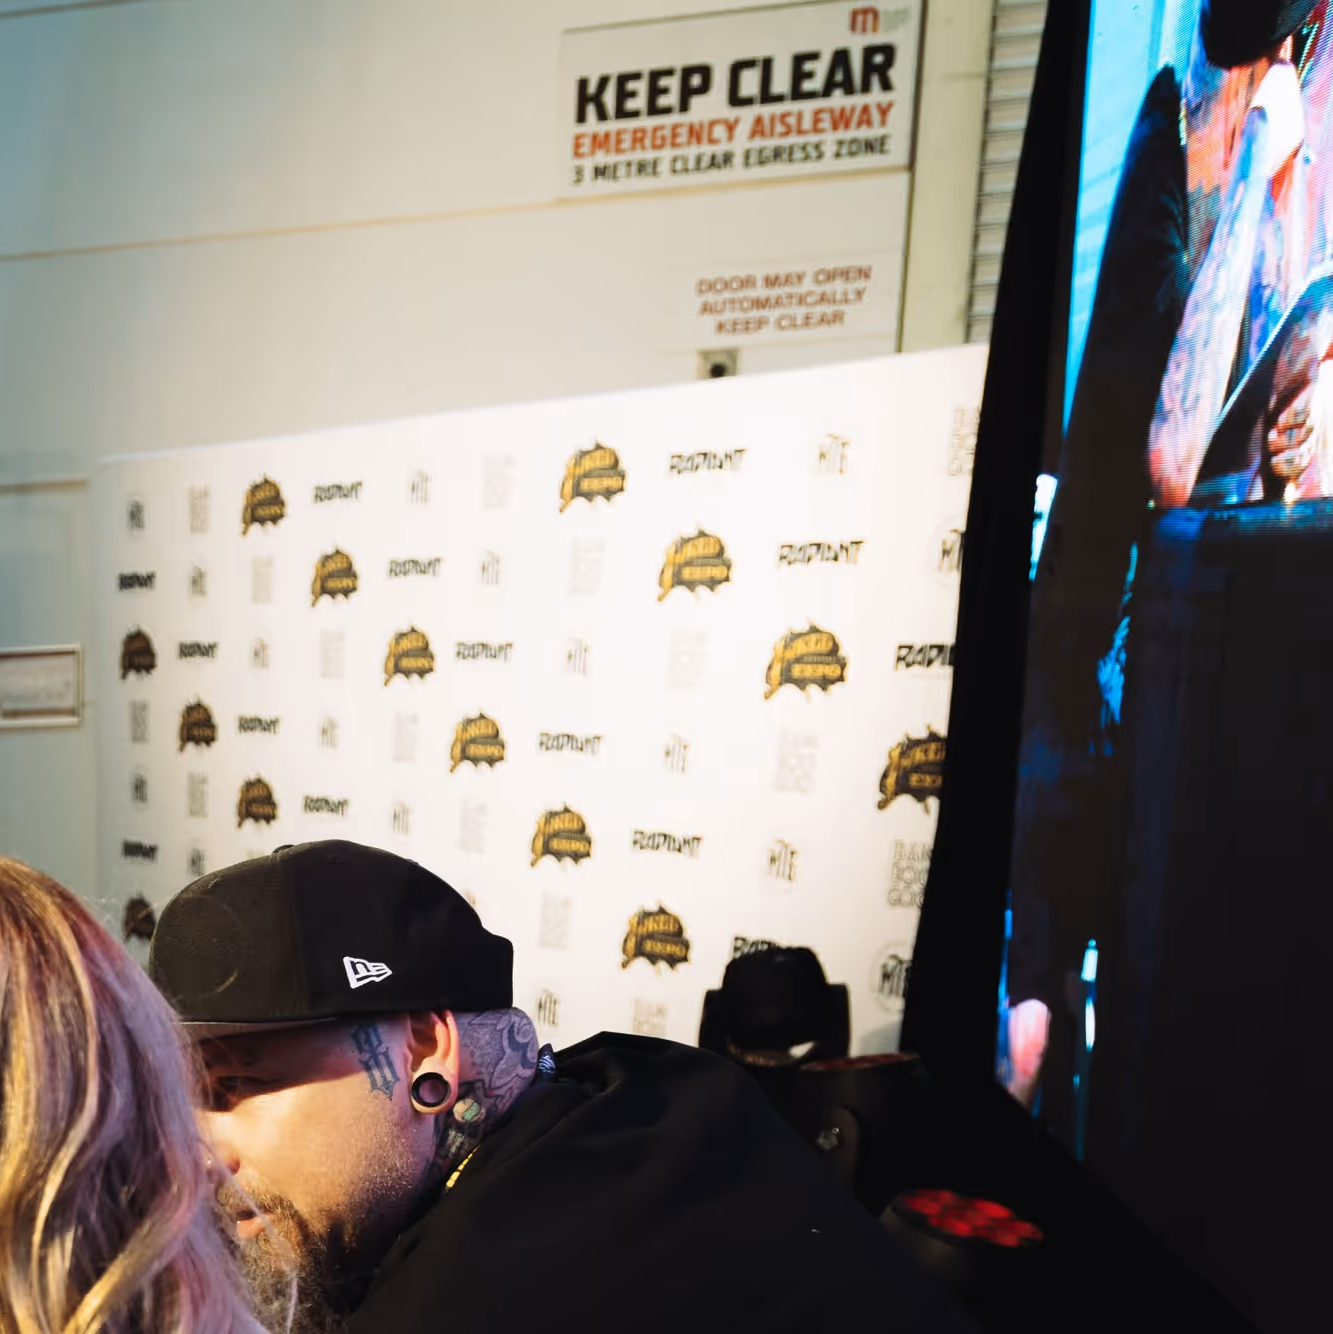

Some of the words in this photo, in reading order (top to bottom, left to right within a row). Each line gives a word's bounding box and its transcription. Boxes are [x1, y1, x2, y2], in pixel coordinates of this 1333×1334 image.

[575, 63, 713, 124] KEEP
[726, 42, 897, 108] CLEAR
[572, 116, 740, 159] EMERGENCY
[748, 100, 896, 140] AISLEWAY
[573, 164, 584, 185] 3
[592, 156, 662, 182] METRE
[670, 150, 734, 176] CLEAR
[743, 141, 825, 169] EGRESS
[833, 134, 892, 160] ZONE
[695, 273, 757, 295] DOOR
[763, 271, 807, 290] MAY
[812, 264, 874, 286] OPEN
[698, 287, 868, 317] AUTOMATICALLY
[715, 315, 770, 336] KEEP
[774, 309, 846, 332] CLEAR
